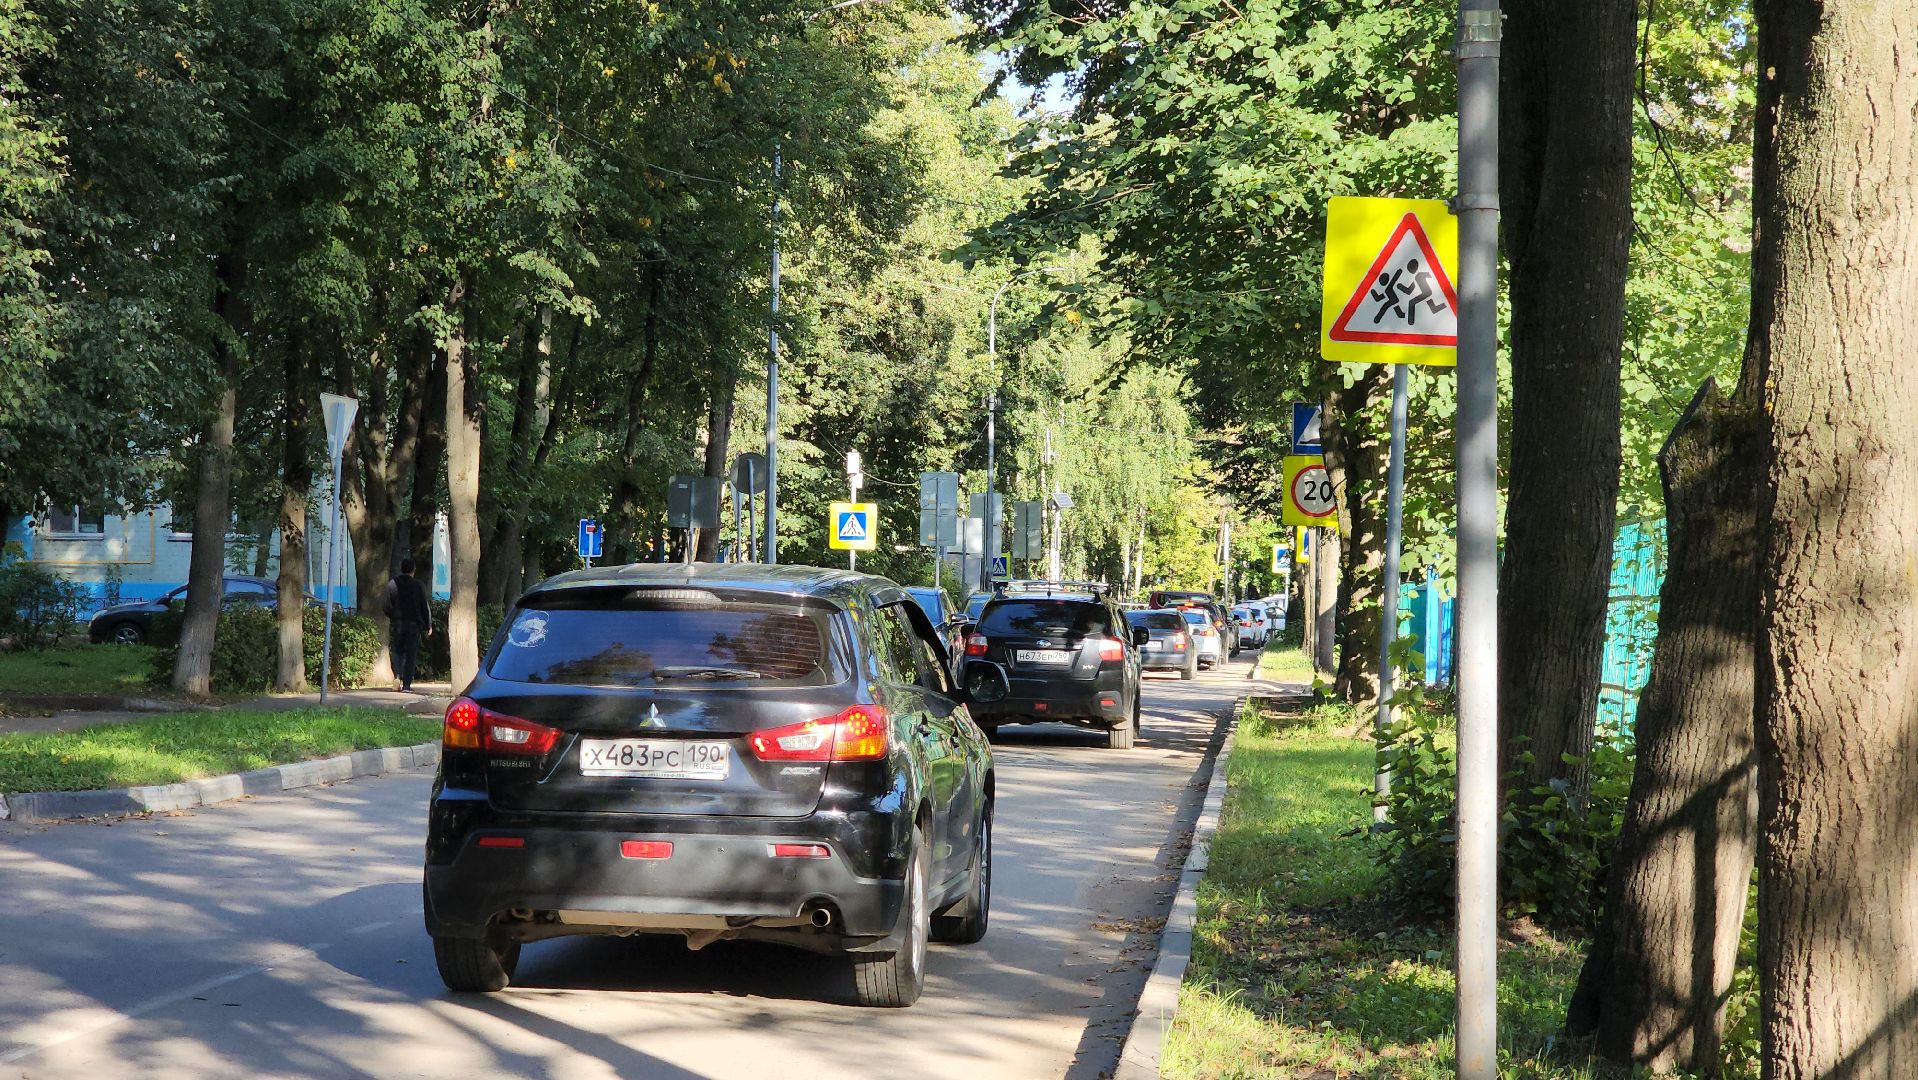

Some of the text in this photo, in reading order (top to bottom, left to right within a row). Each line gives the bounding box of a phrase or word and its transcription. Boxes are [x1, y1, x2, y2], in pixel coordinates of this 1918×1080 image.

[1304, 480, 1333, 503] 20
[590, 744, 721, 767] Х483РС 190
[693, 762, 711, 770] RUS
